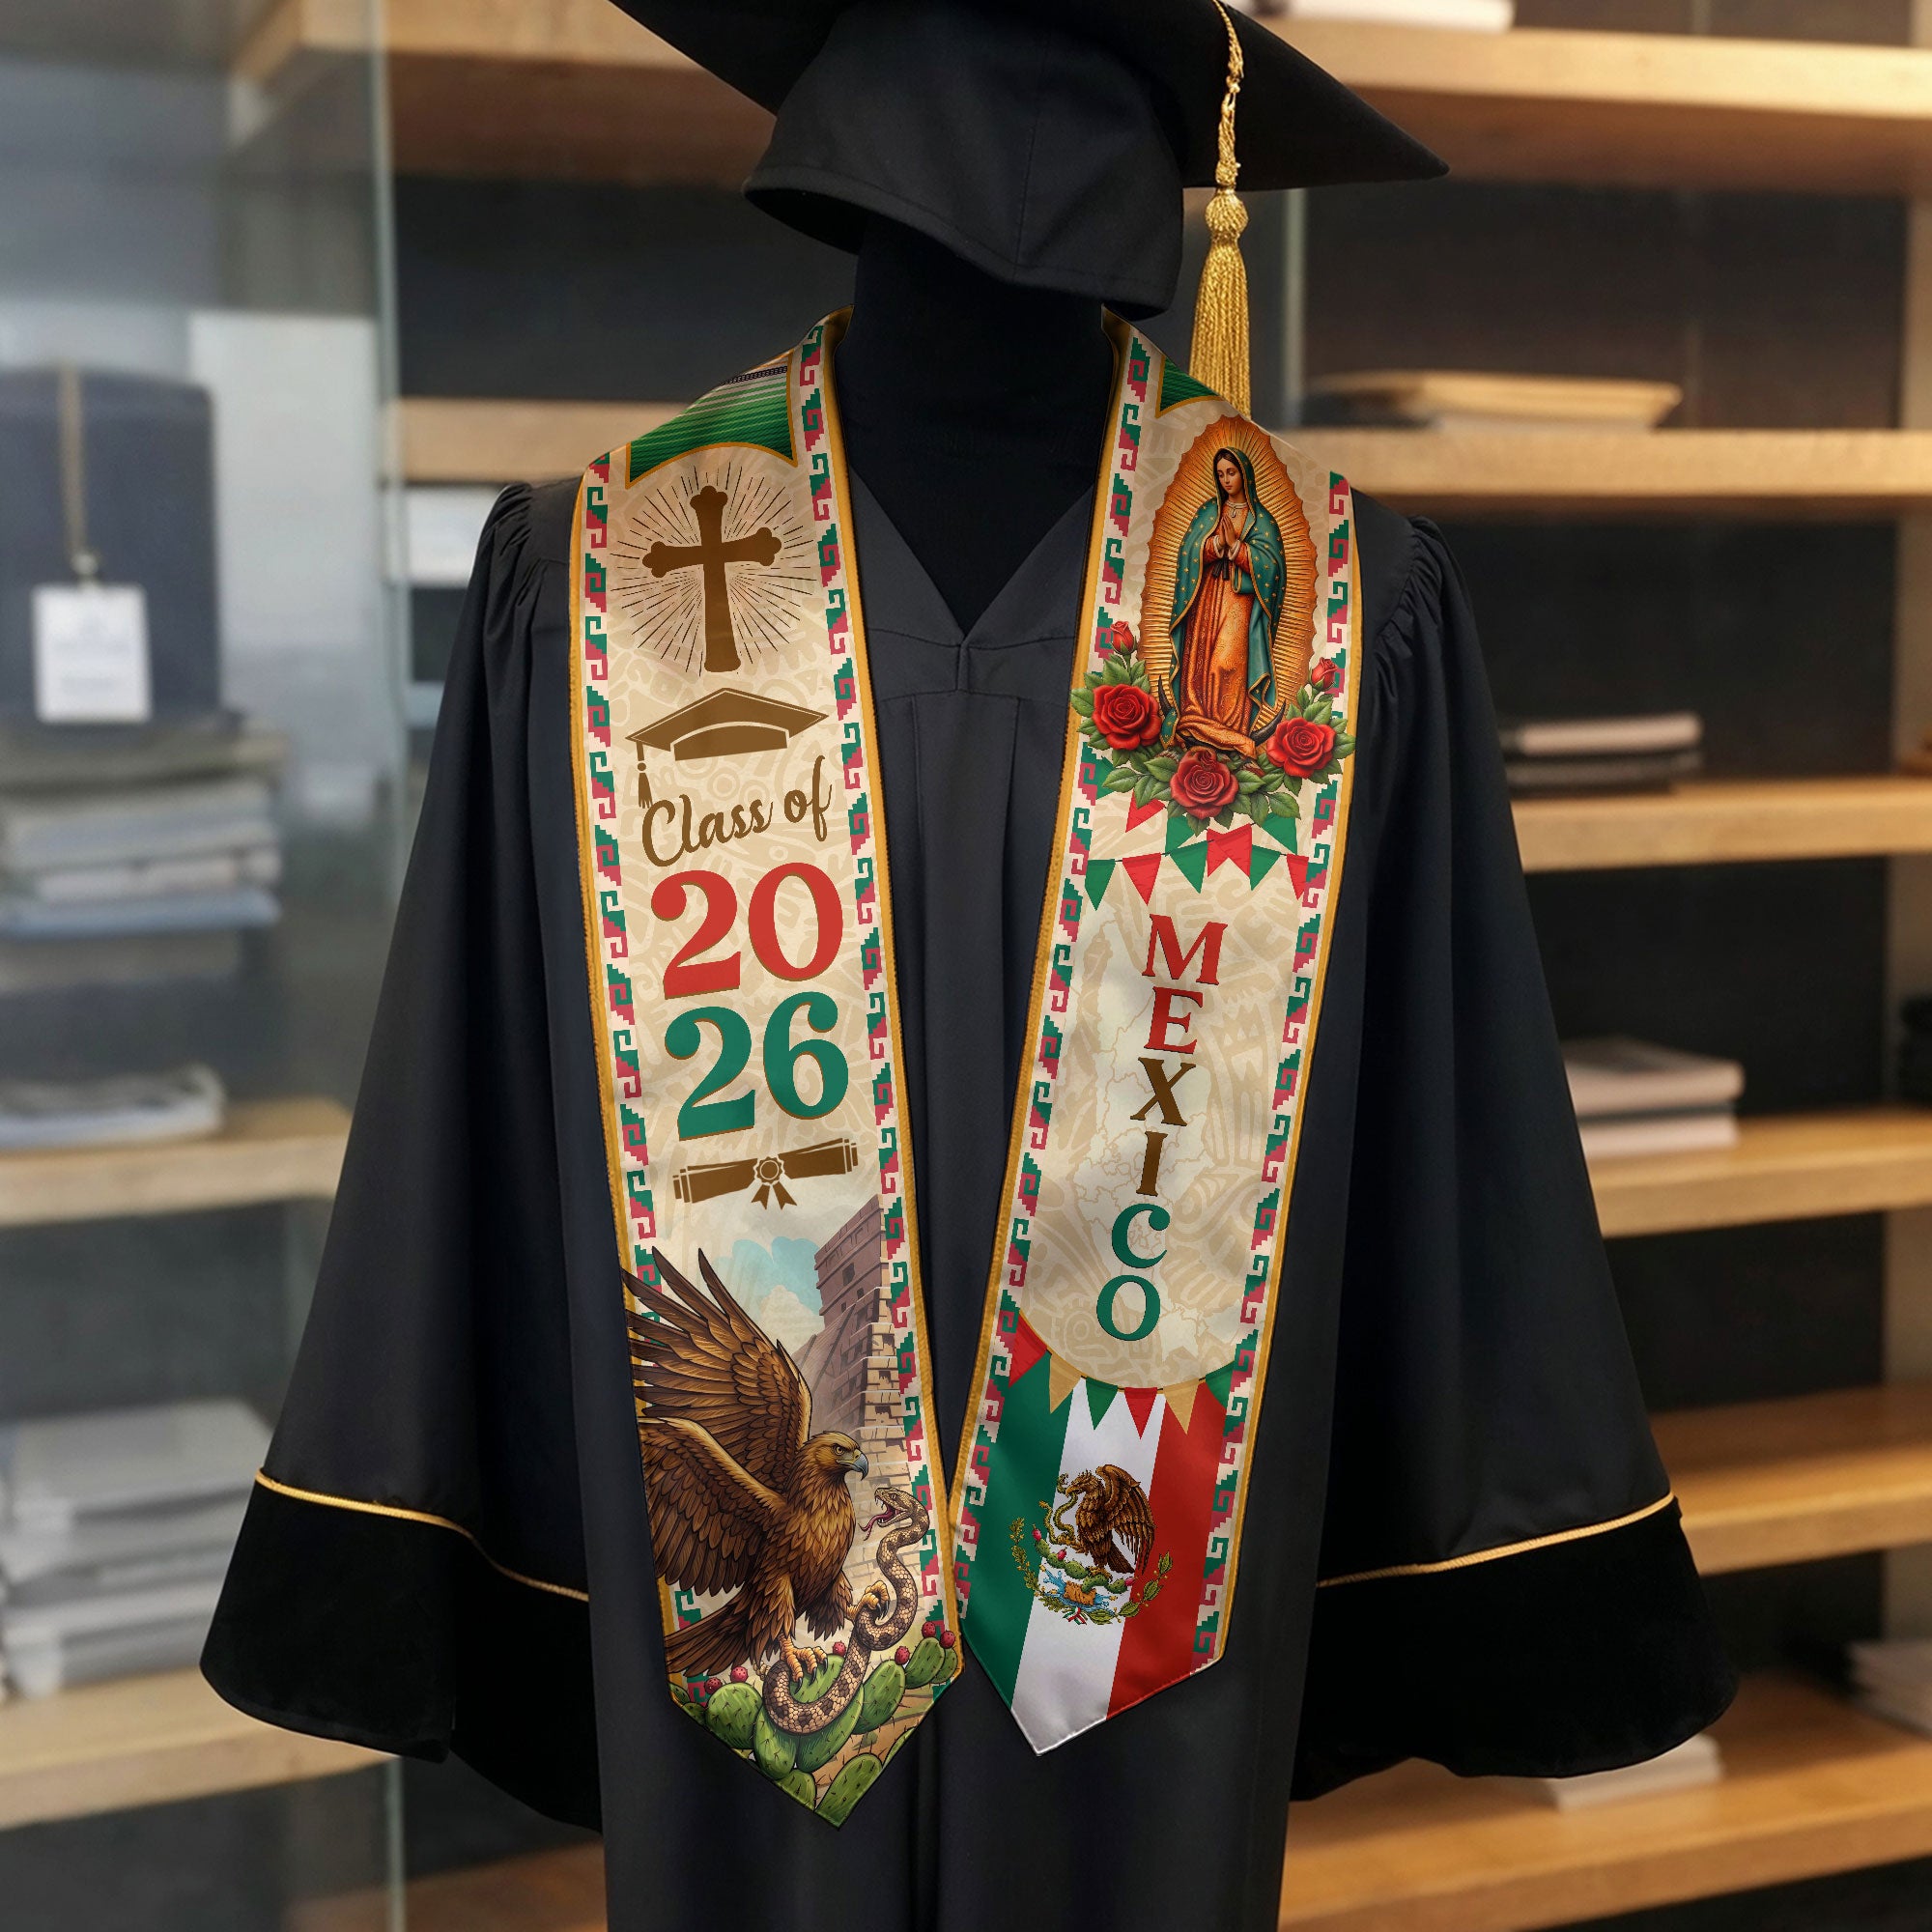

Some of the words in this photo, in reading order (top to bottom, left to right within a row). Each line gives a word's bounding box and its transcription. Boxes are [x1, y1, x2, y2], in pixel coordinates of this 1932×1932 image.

[642, 794, 773, 867] Class
[783, 754, 833, 841] of
[650, 862, 843, 1000] 20
[664, 991, 849, 1141] 26
[1095, 913, 1228, 1341] MEXICO
